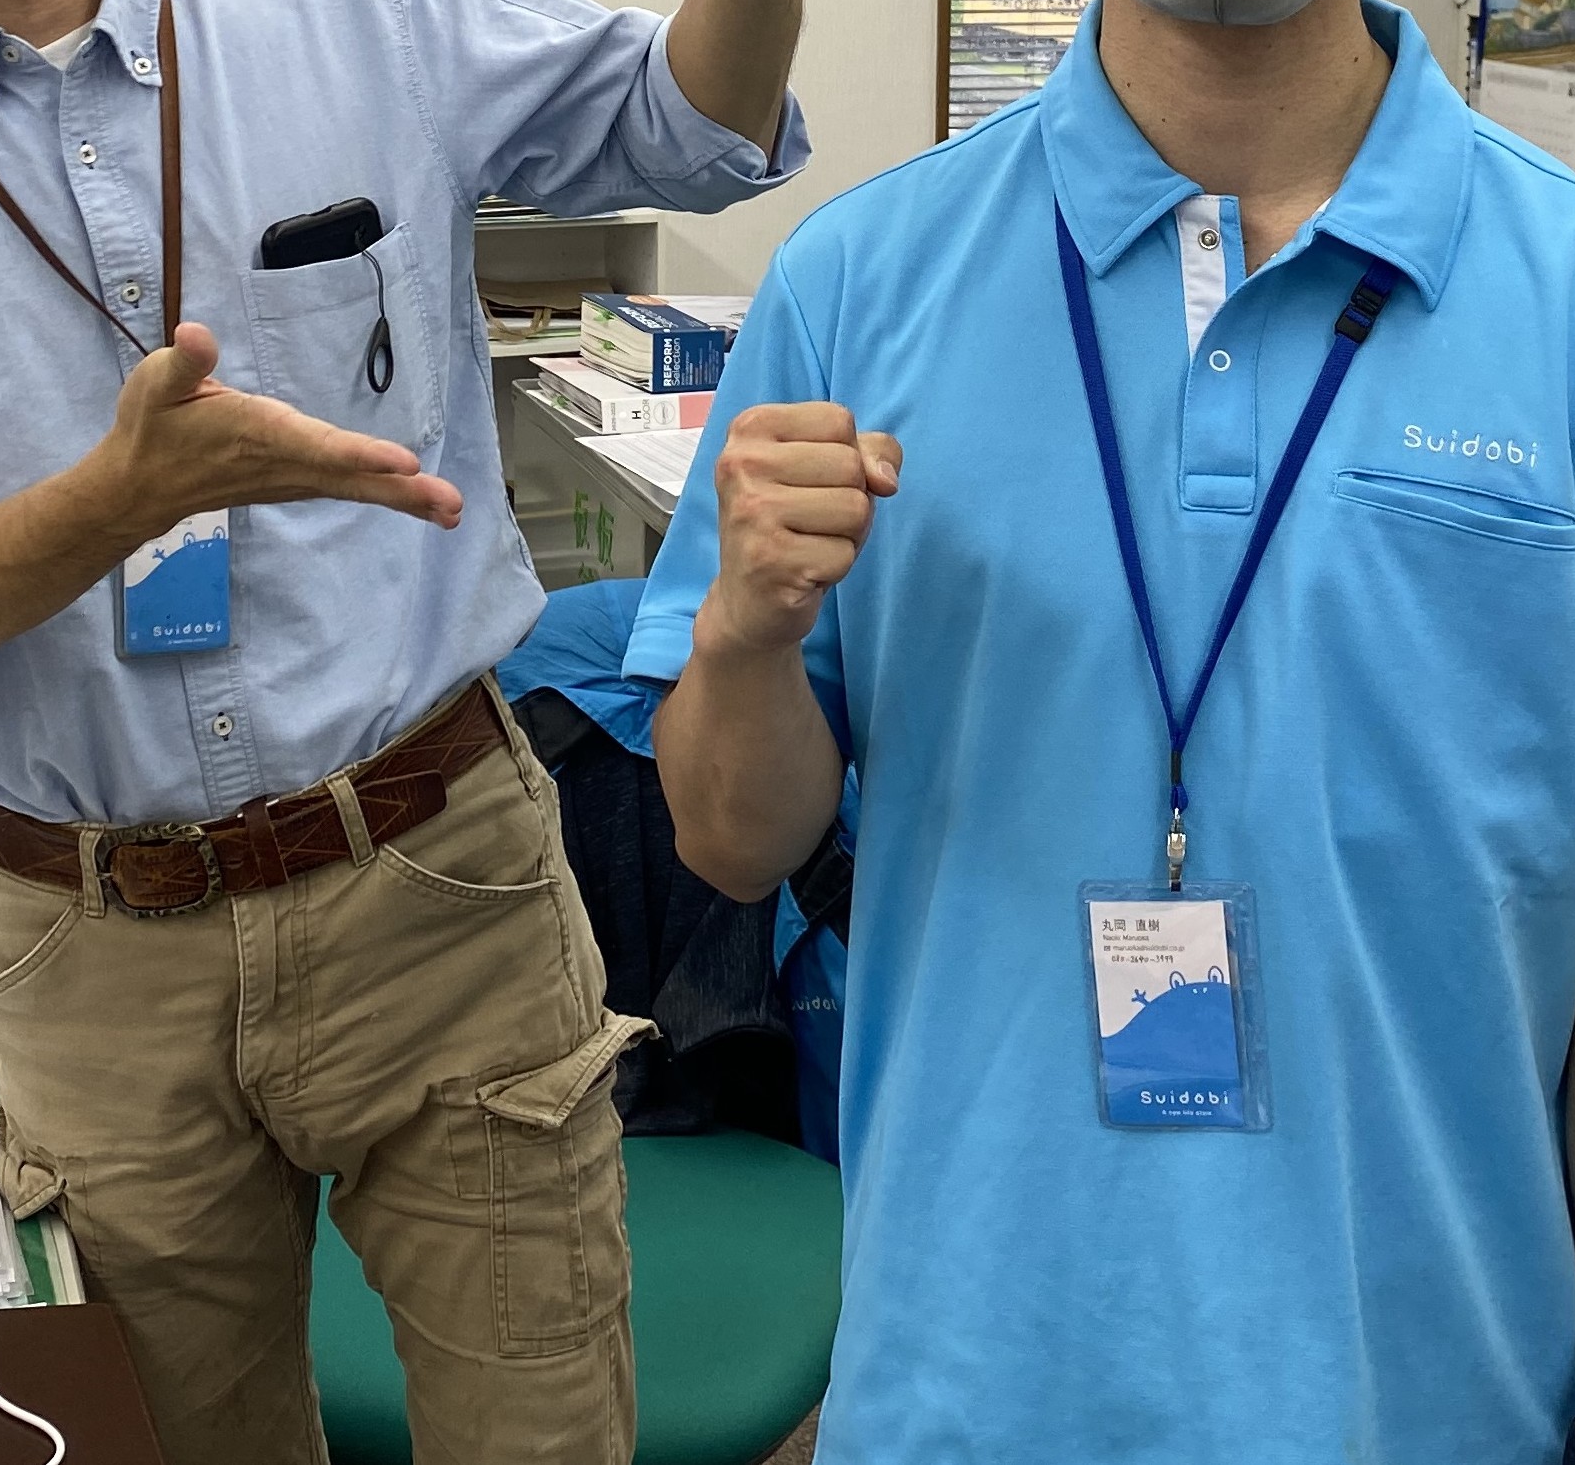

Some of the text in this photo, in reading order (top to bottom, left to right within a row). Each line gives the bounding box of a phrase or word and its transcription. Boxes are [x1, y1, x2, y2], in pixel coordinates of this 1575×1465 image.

[663, 337, 673, 387] REFORM
[672, 337, 681, 387] Selection
[1402, 424, 1539, 468] Suidobi
[152, 620, 222, 637] Suidobi
[1140, 1090, 1229, 1105] Suidobi
